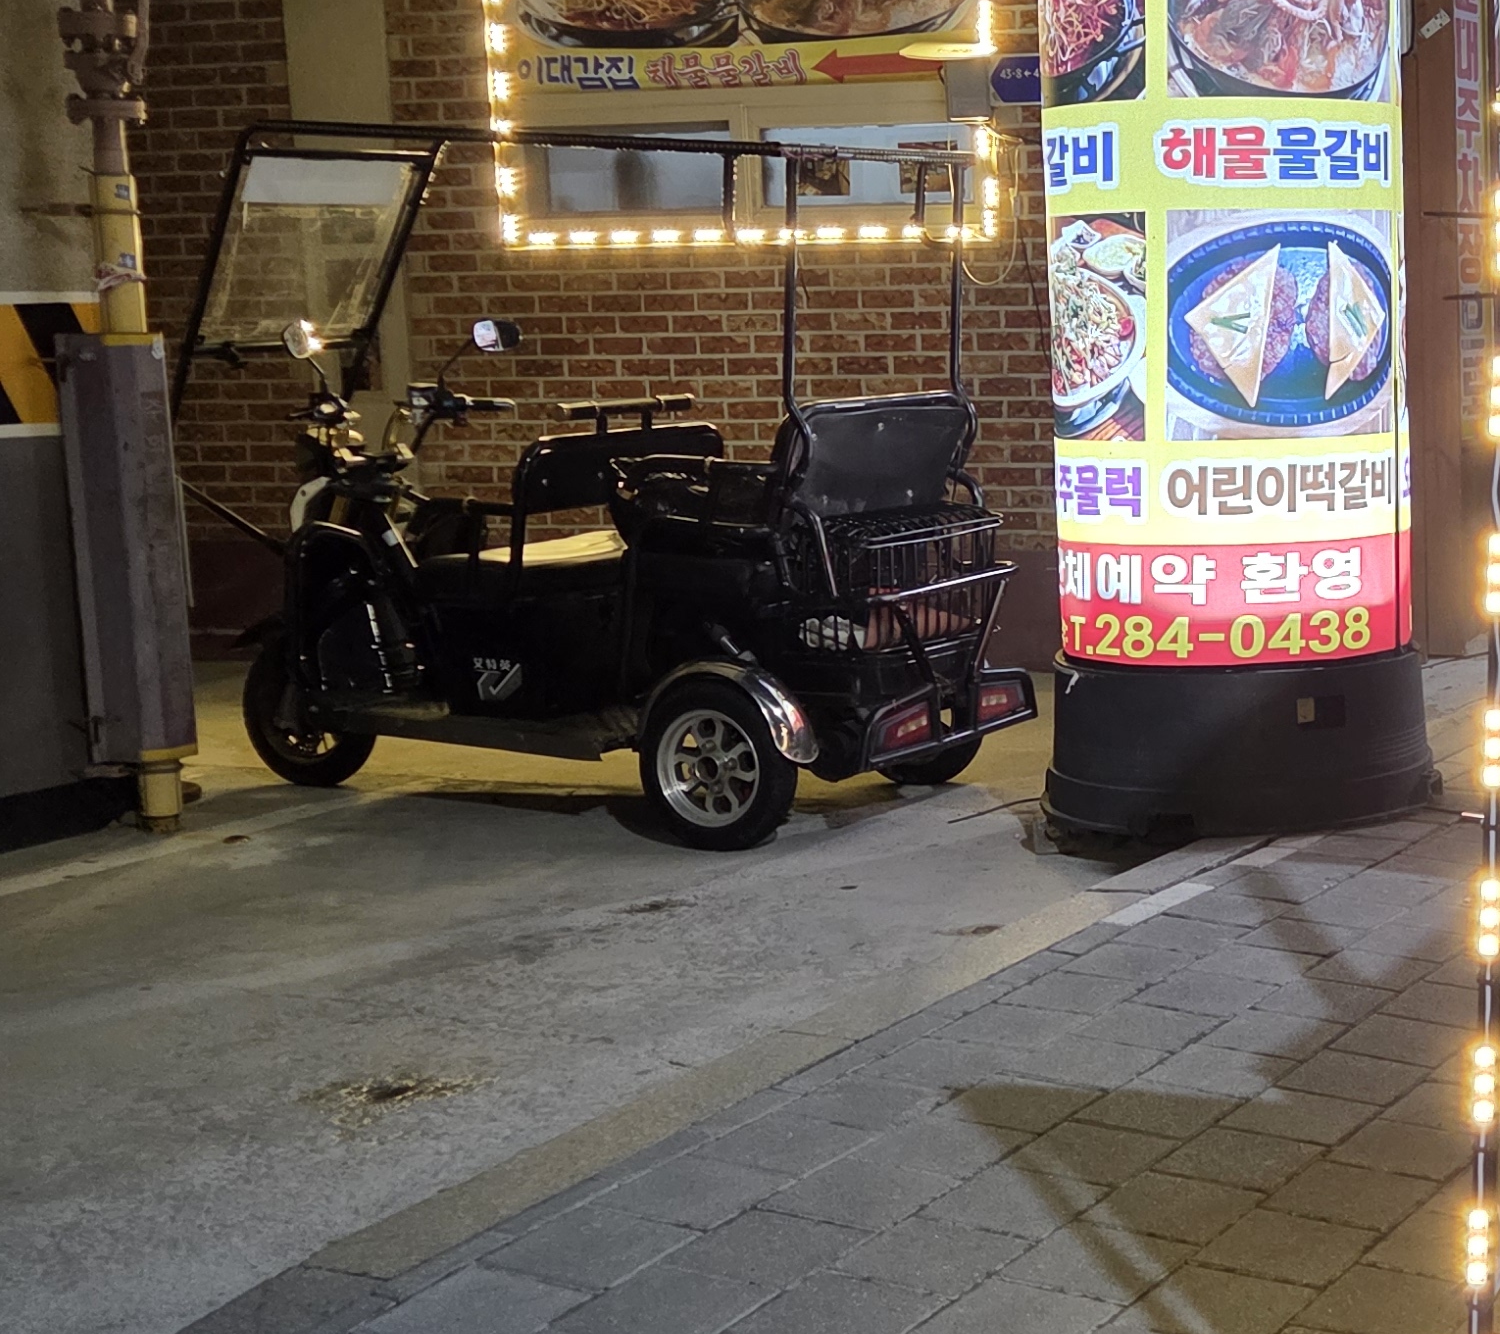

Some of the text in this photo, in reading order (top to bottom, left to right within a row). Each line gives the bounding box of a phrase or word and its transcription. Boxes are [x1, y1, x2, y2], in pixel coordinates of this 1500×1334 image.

[517, 53, 640, 91] 이대감집
[1161, 125, 1390, 182] 해물물갈비
[1166, 460, 1392, 517] 어린이떡갈비
[1239, 546, 1363, 605] 환영
